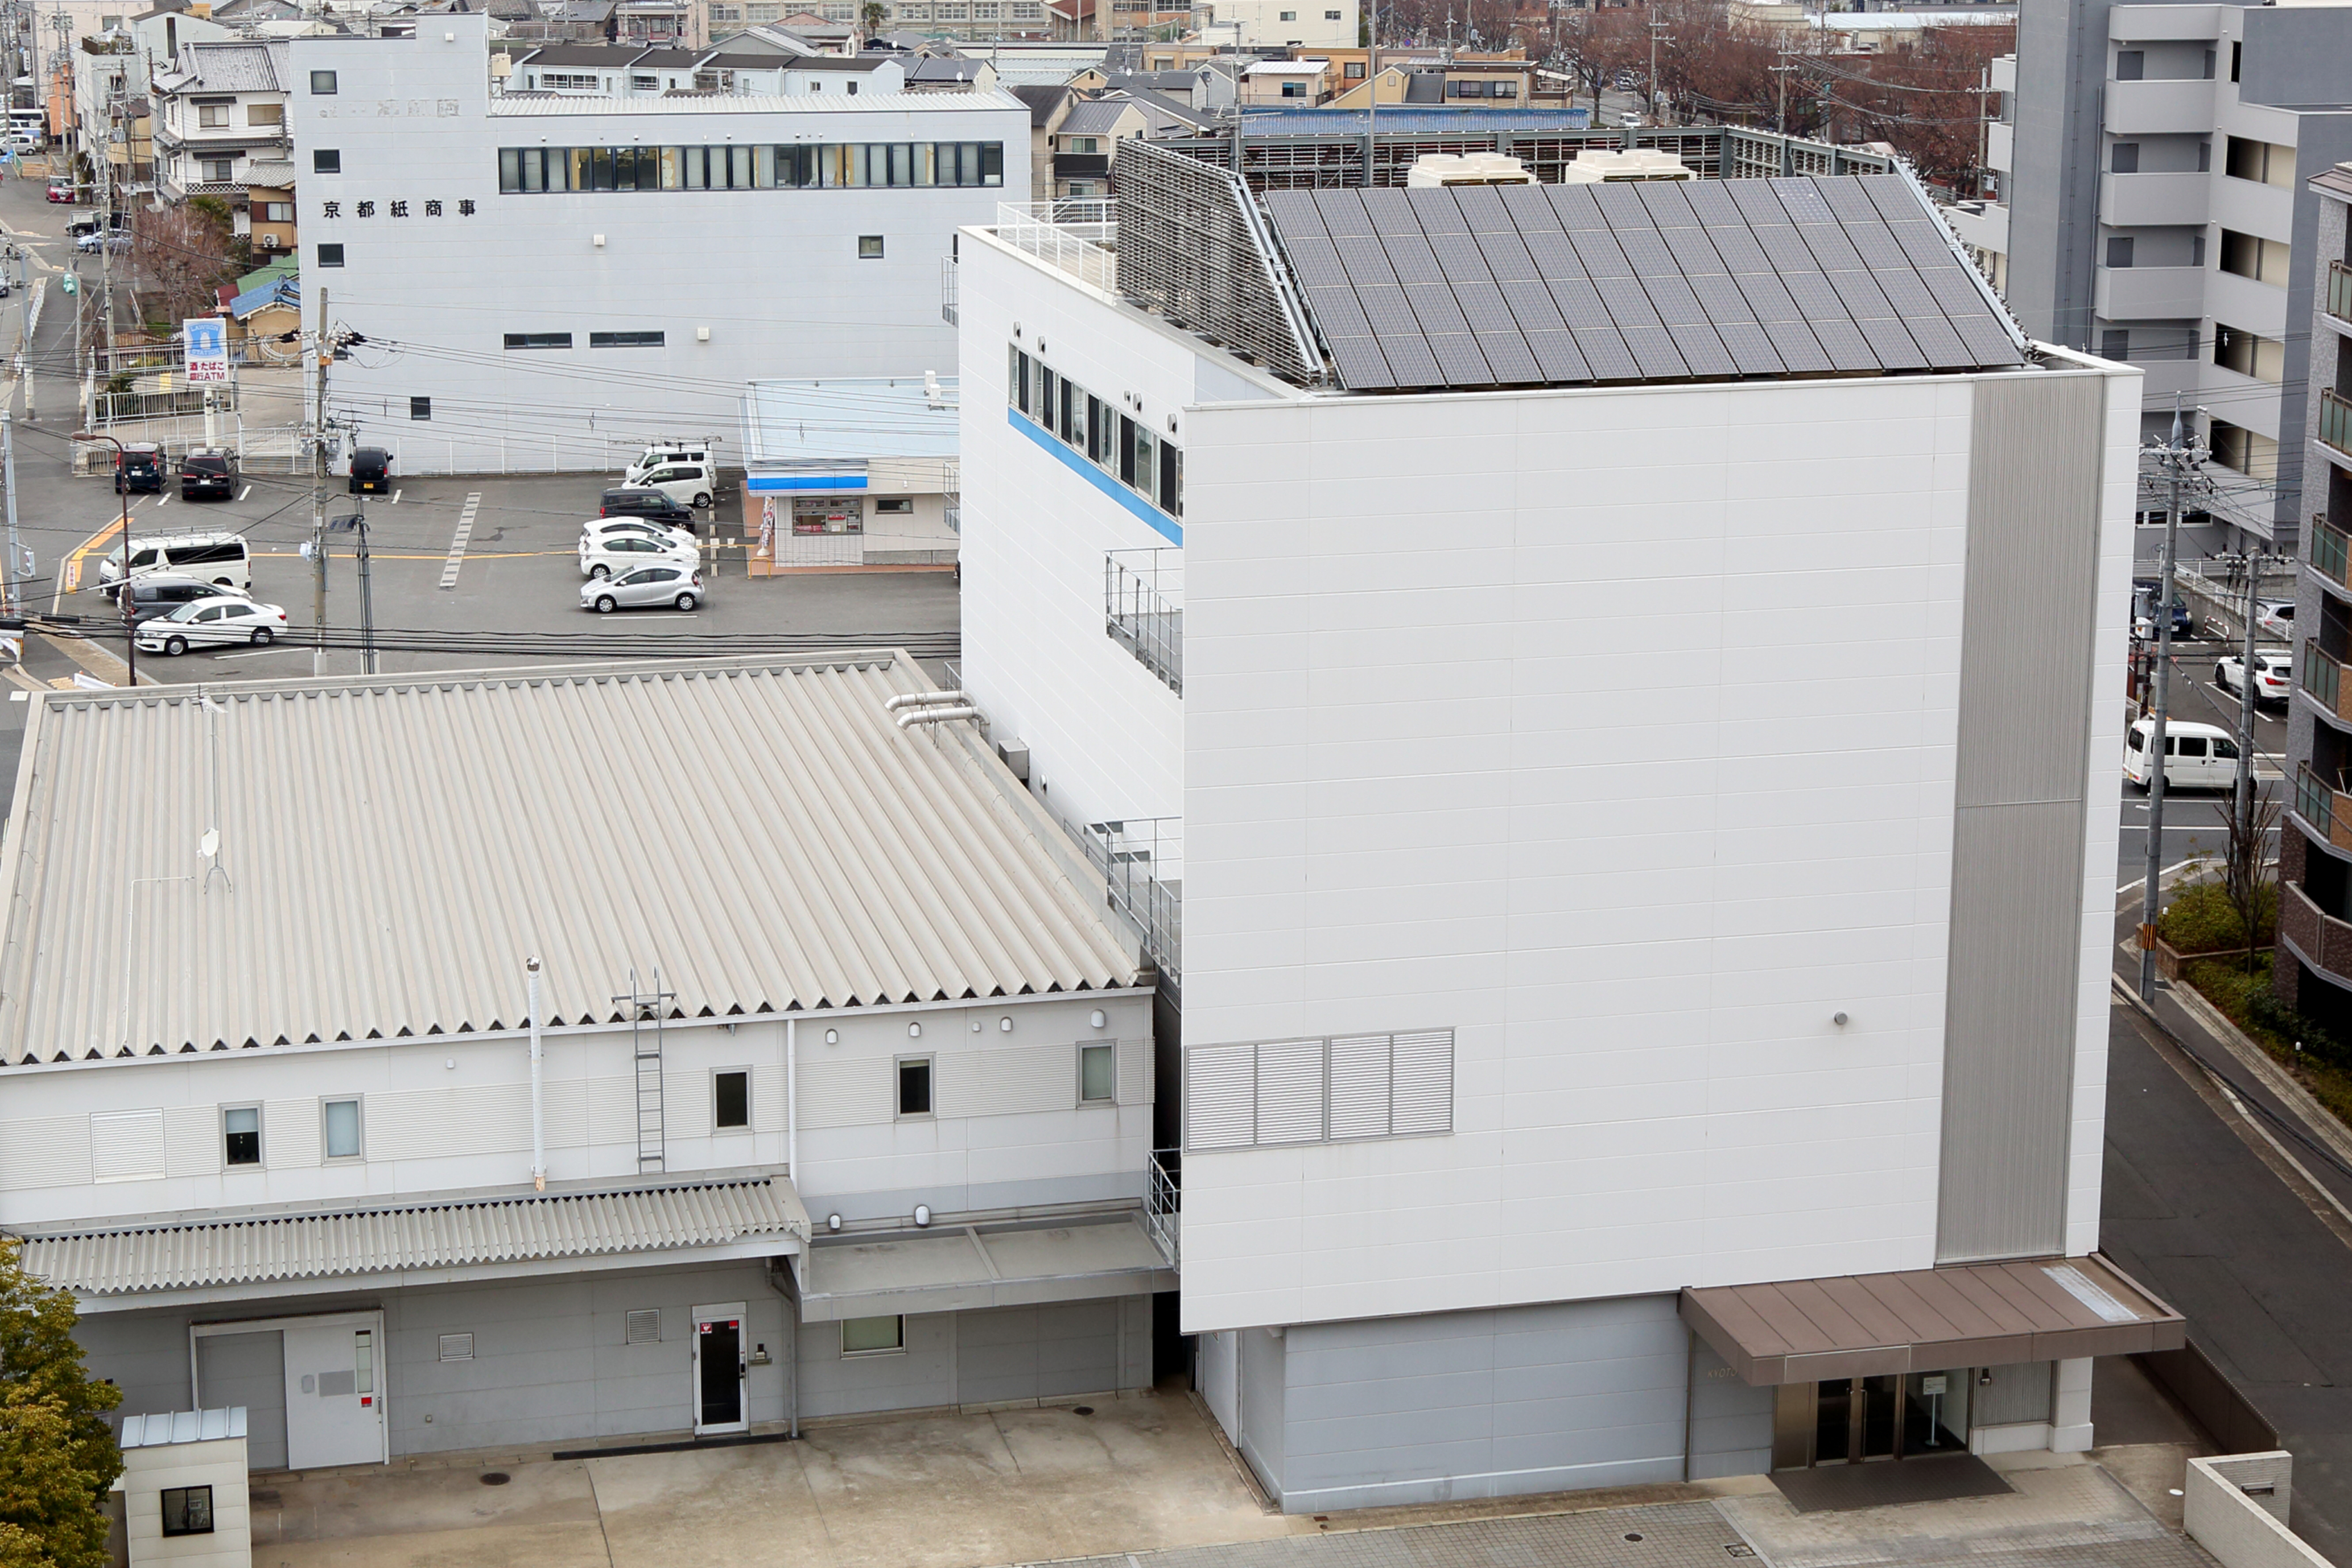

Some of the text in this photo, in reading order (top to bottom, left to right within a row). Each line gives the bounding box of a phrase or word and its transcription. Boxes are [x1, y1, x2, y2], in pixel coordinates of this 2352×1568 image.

[323, 199, 476, 218] 京都紙商事
[1707, 1368, 1738, 1378] KYOTO
